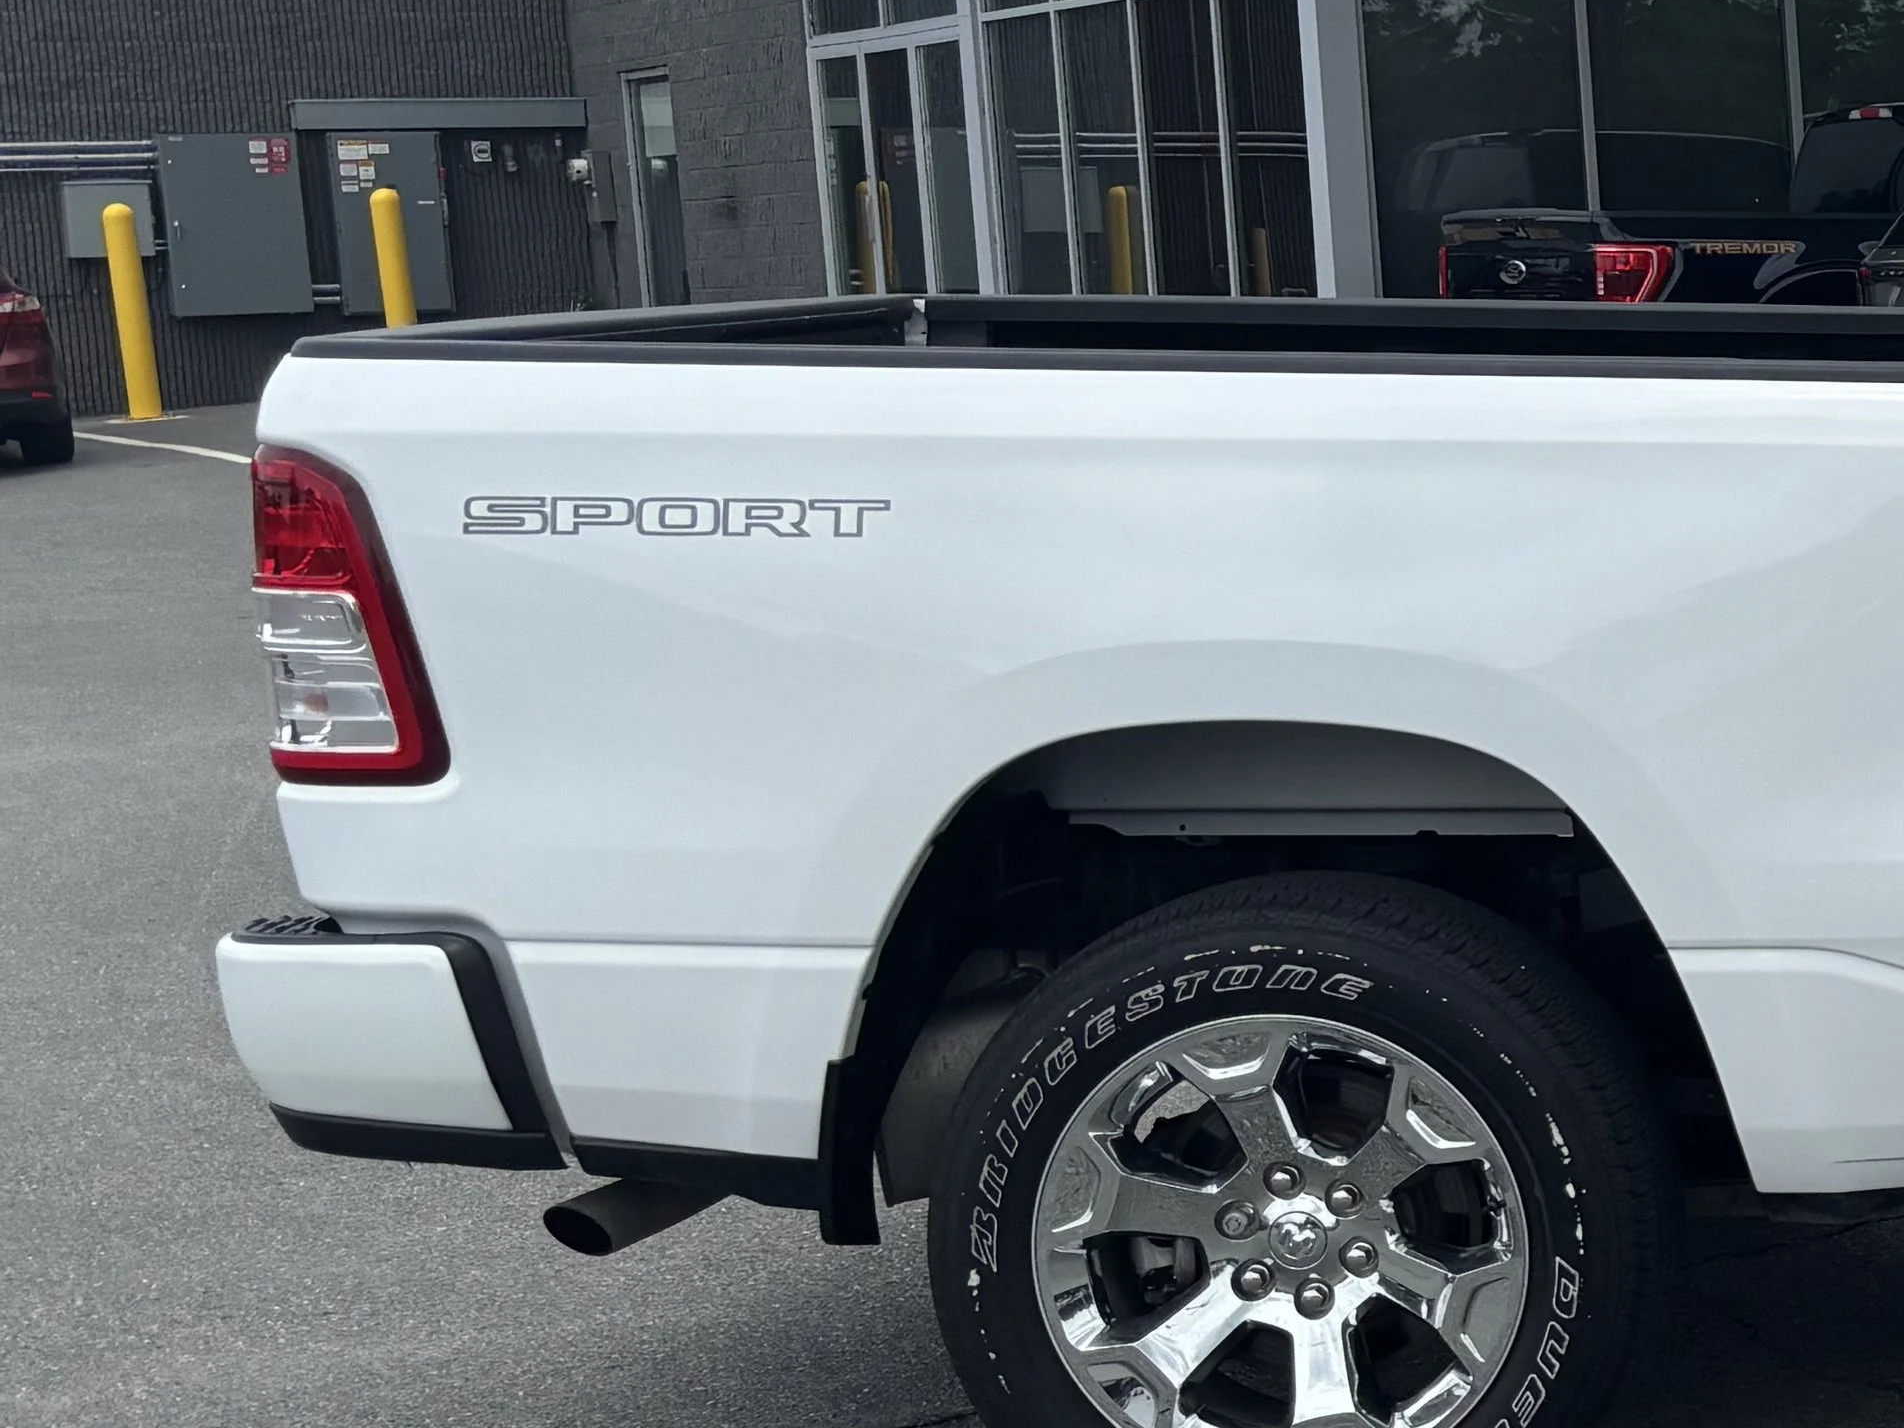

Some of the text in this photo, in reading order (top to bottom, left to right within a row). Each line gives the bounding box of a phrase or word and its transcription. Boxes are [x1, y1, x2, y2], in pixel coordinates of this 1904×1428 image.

[1692, 242, 1797, 254] TREMOR
[462, 495, 892, 538] SPORT
[970, 964, 1373, 1273] BRIDGESTONE
